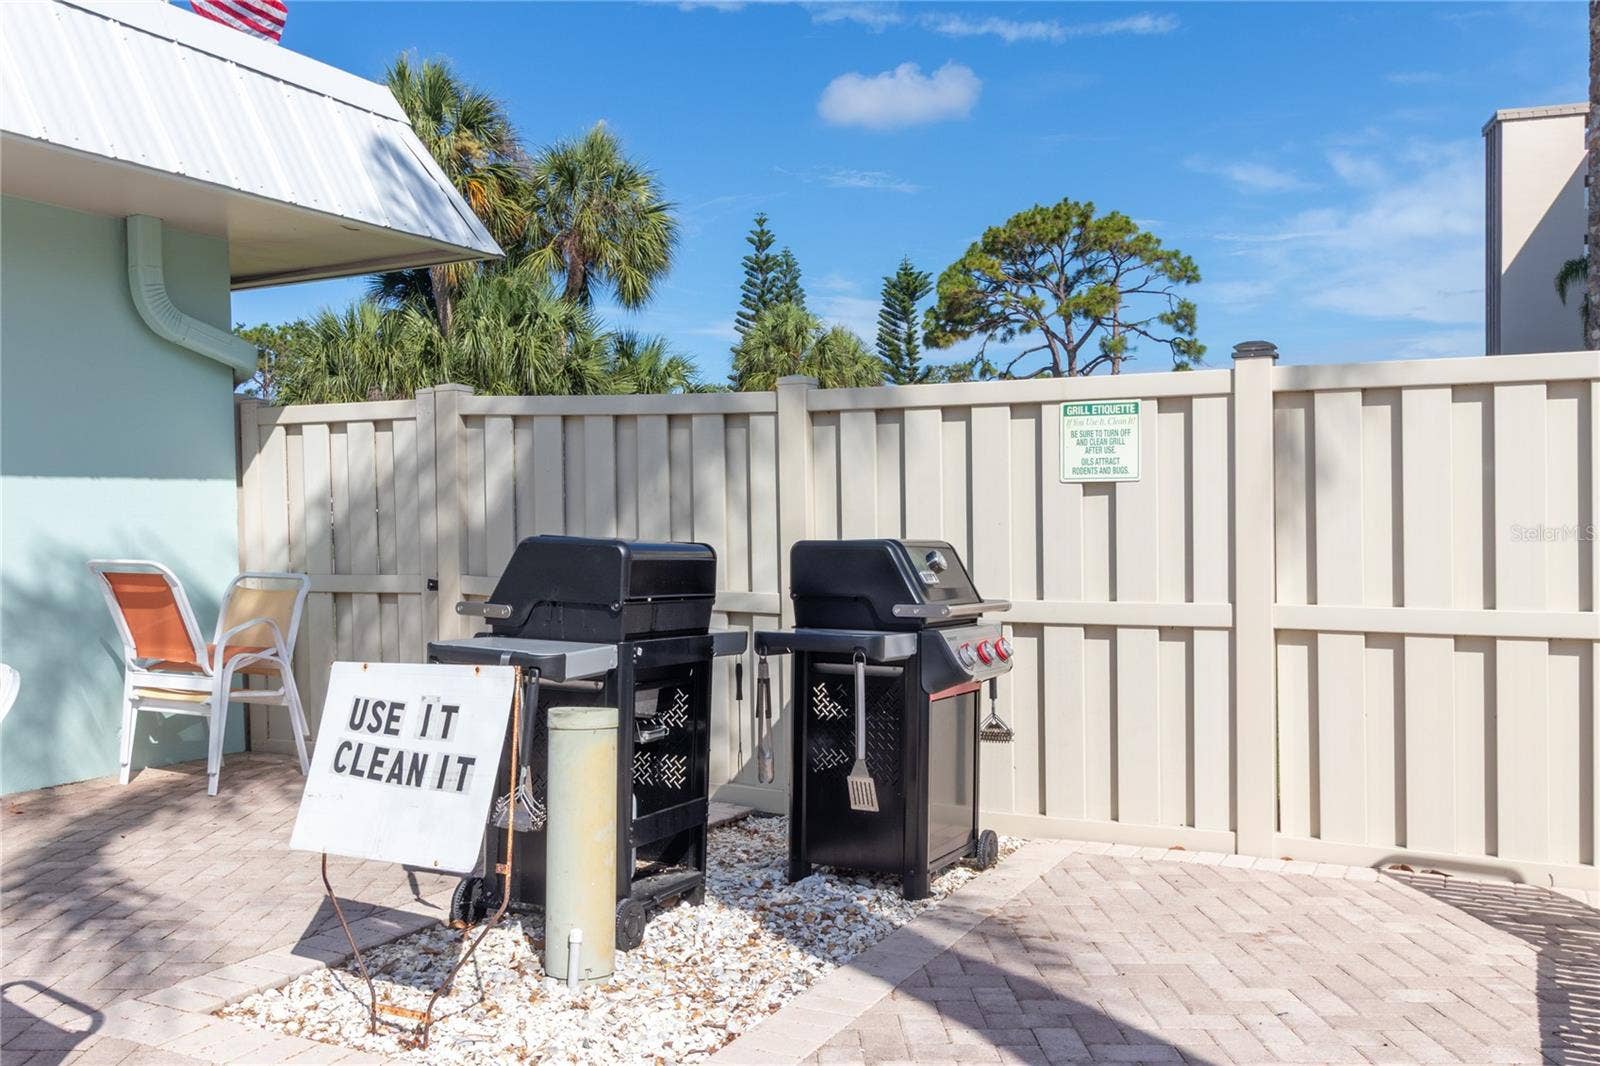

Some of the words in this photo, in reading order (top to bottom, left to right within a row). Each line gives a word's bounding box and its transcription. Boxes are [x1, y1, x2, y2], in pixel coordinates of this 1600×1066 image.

[1066, 405, 1090, 415] GRILL
[1092, 404, 1136, 414] ETIQUETTE
[1066, 418, 1072, 426] If
[1074, 418, 1084, 426] You
[1086, 418, 1098, 426] Use
[1108, 416, 1126, 425] Clean
[1071, 430, 1078, 438] BE
[1079, 430, 1094, 438] SURE
[1095, 429, 1102, 437] TO
[1104, 428, 1118, 437] TURN
[1120, 428, 1131, 437] OFF
[1076, 438, 1088, 446] AND
[1090, 438, 1108, 446] CLEAN
[1108, 437, 1126, 445] GRILL
[1085, 446, 1102, 454] AFTER
[1080, 457, 1094, 466] OILS
[1095, 457, 1120, 465] ATTRACT
[1072, 466, 1098, 475] RODENTS
[1099, 466, 1112, 474] AND
[1112, 466, 1130, 474] BUGS.
[349, 698, 406, 736] USE
[420, 704, 460, 739] IT
[334, 740, 429, 788] CLEAN
[436, 755, 476, 792] IT
